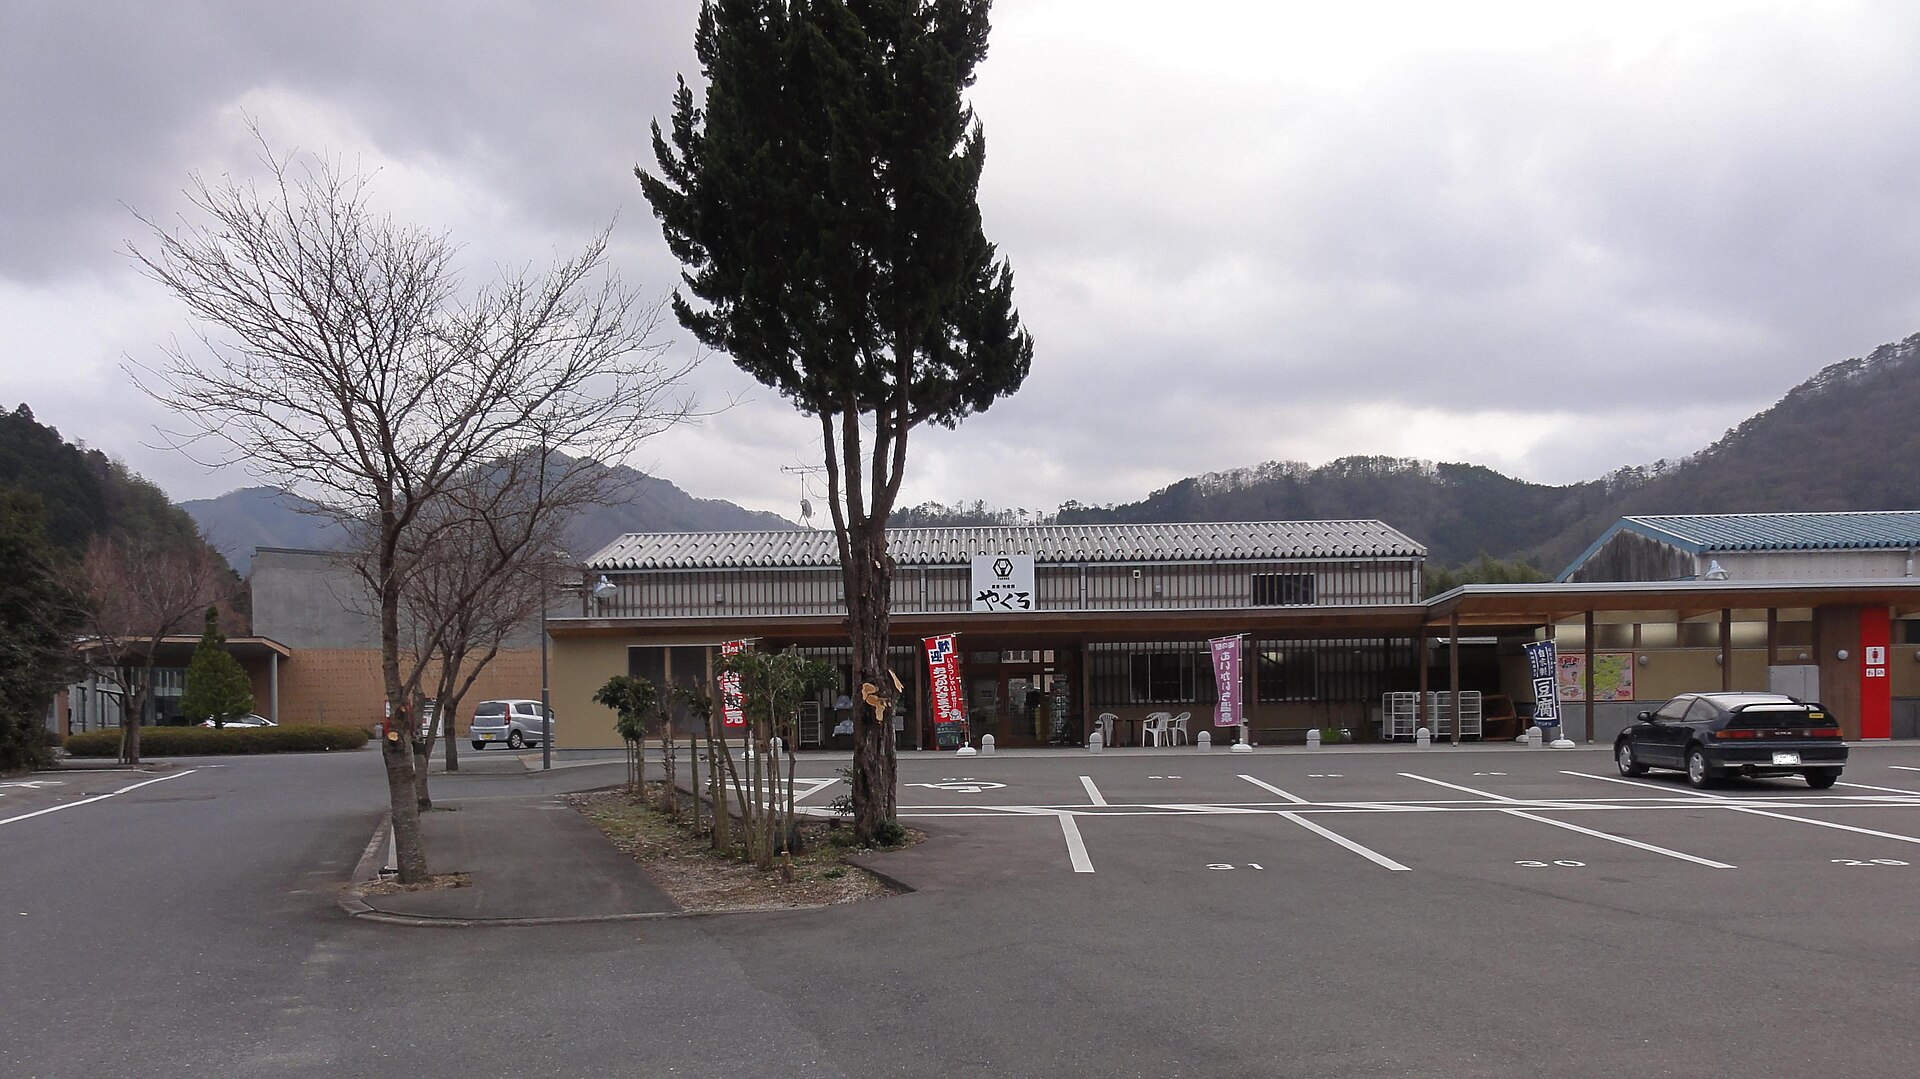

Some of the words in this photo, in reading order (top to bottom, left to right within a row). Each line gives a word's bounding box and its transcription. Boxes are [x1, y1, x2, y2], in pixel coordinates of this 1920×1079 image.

[975, 590, 1030, 611] やくろ
[1537, 680, 1553, 717] 豆腐
